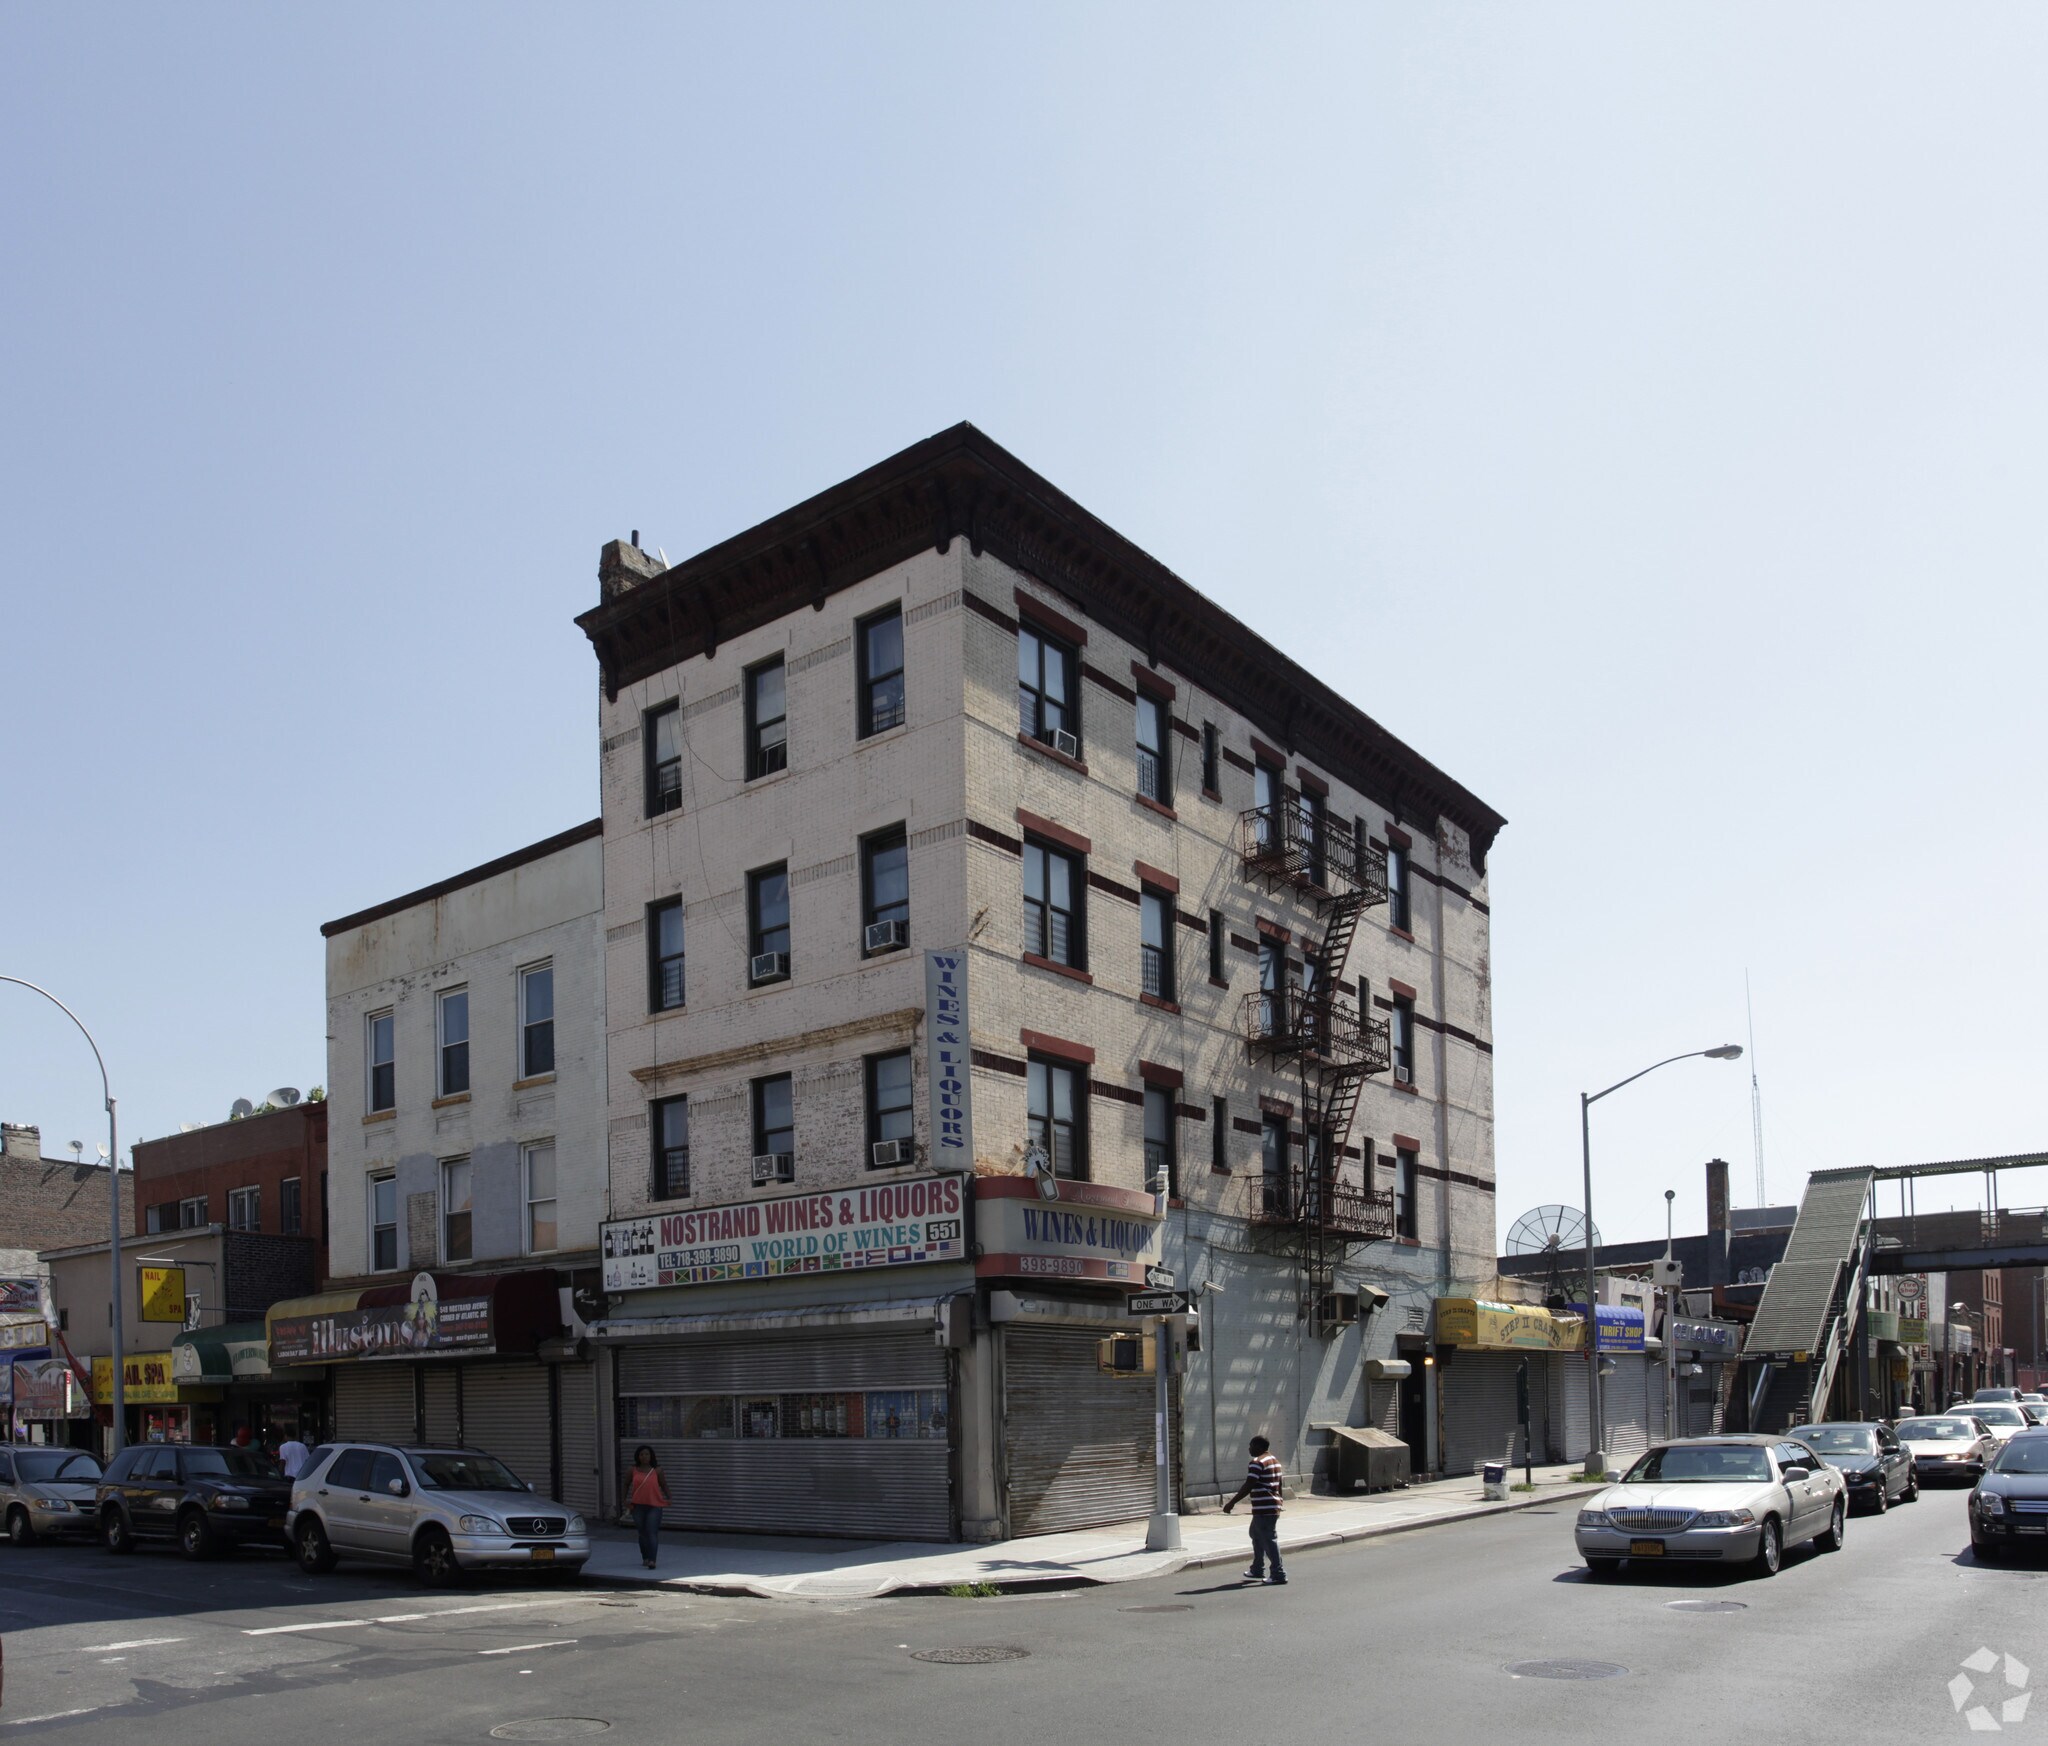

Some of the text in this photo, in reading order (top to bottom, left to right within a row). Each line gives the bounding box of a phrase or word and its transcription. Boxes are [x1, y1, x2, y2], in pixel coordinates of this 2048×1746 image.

[932, 956, 964, 1149] WINES & LIQUORS
[660, 1178, 960, 1247] NOSTRAND WINES & LIQUORS
[929, 1222, 957, 1240] 551
[1023, 1207, 1154, 1257] WINES & LIQUORS
[751, 1223, 921, 1260] WORLD OF WINES
[1021, 1257, 1083, 1274] 398-9890
[144, 1271, 161, 1281] NAIL
[1149, 1272, 1172, 1284] ONE WAY
[169, 1304, 182, 1314] SPA
[1136, 1298, 1180, 1309] ONE WAY
[312, 1316, 414, 1355] illusions
[1500, 1316, 1520, 1341] STEP
[1522, 1316, 1530, 1328] II
[1600, 1325, 1643, 1338] THRIFT SHOP
[1688, 1325, 1726, 1344] LOUNGE
[124, 1364, 142, 1385] AIL
[144, 1363, 165, 1384] SPA
